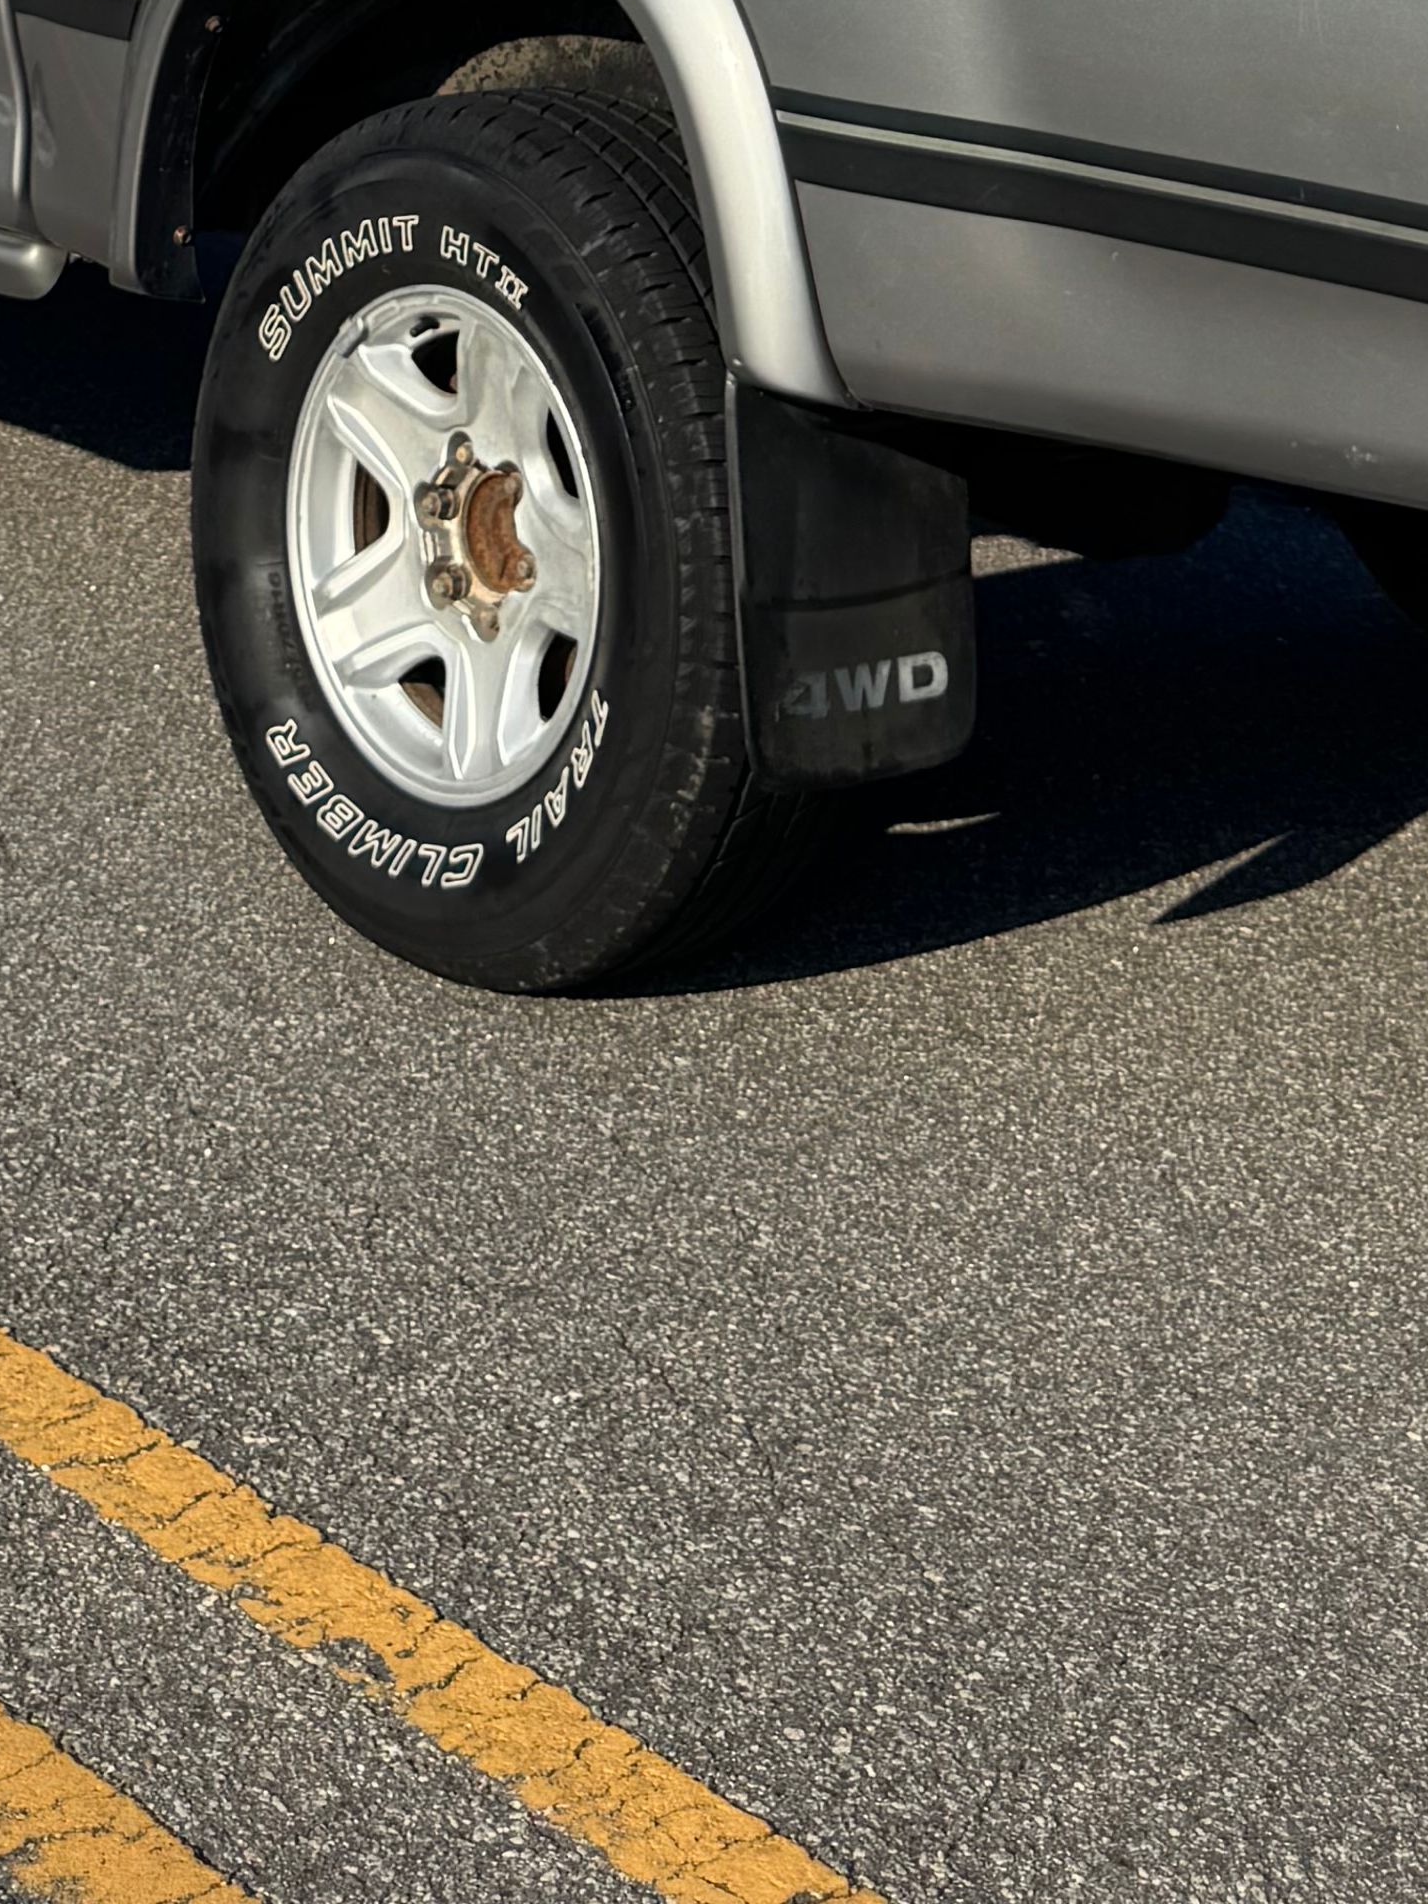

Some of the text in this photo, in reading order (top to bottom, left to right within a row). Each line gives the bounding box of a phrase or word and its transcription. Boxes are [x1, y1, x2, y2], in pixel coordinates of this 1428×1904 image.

[258, 214, 419, 361] SUMMIT
[781, 650, 948, 720] 4WD
[266, 689, 609, 888] TRAIL CLIMBER
